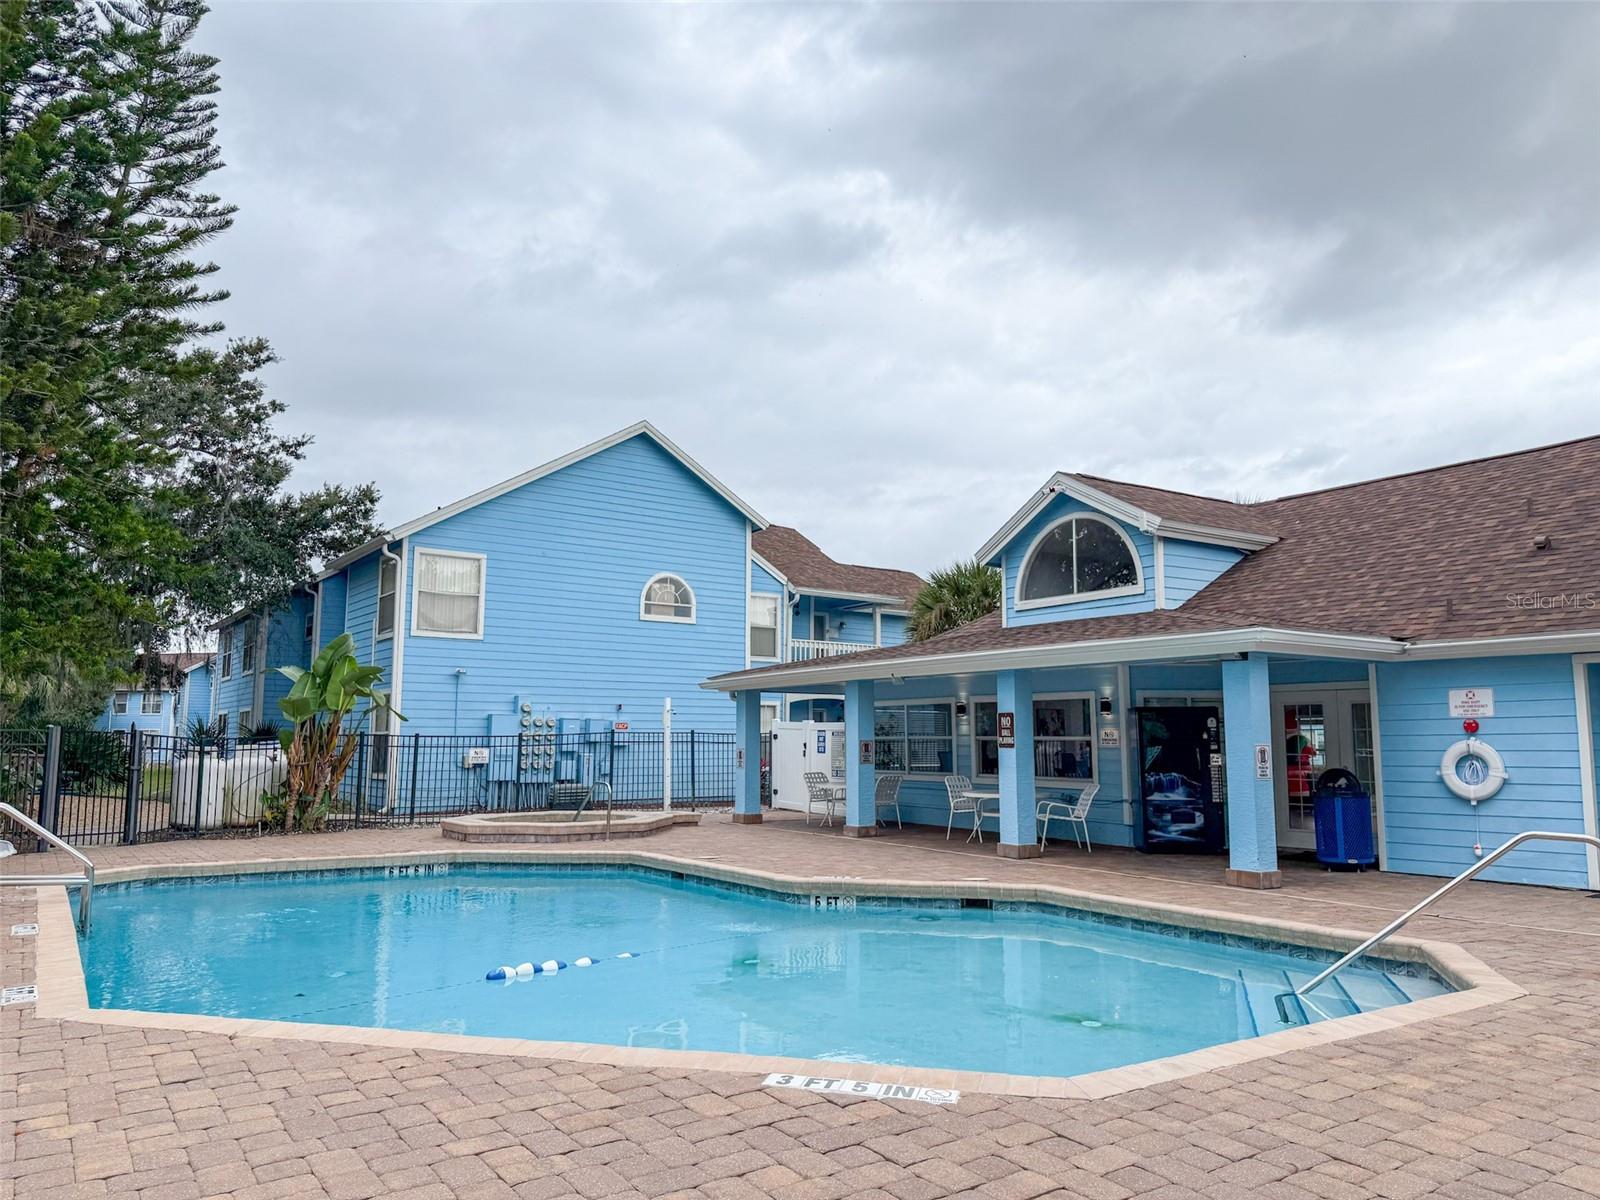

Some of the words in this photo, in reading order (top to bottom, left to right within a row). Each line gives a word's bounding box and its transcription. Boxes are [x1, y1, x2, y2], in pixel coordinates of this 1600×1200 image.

[1001, 716, 1011, 727] NO
[827, 896, 840, 906] FT
[775, 1074, 795, 1086] 3
[803, 1077, 841, 1089] FT
[851, 1081, 869, 1093] 5
[883, 1084, 915, 1098] IN
